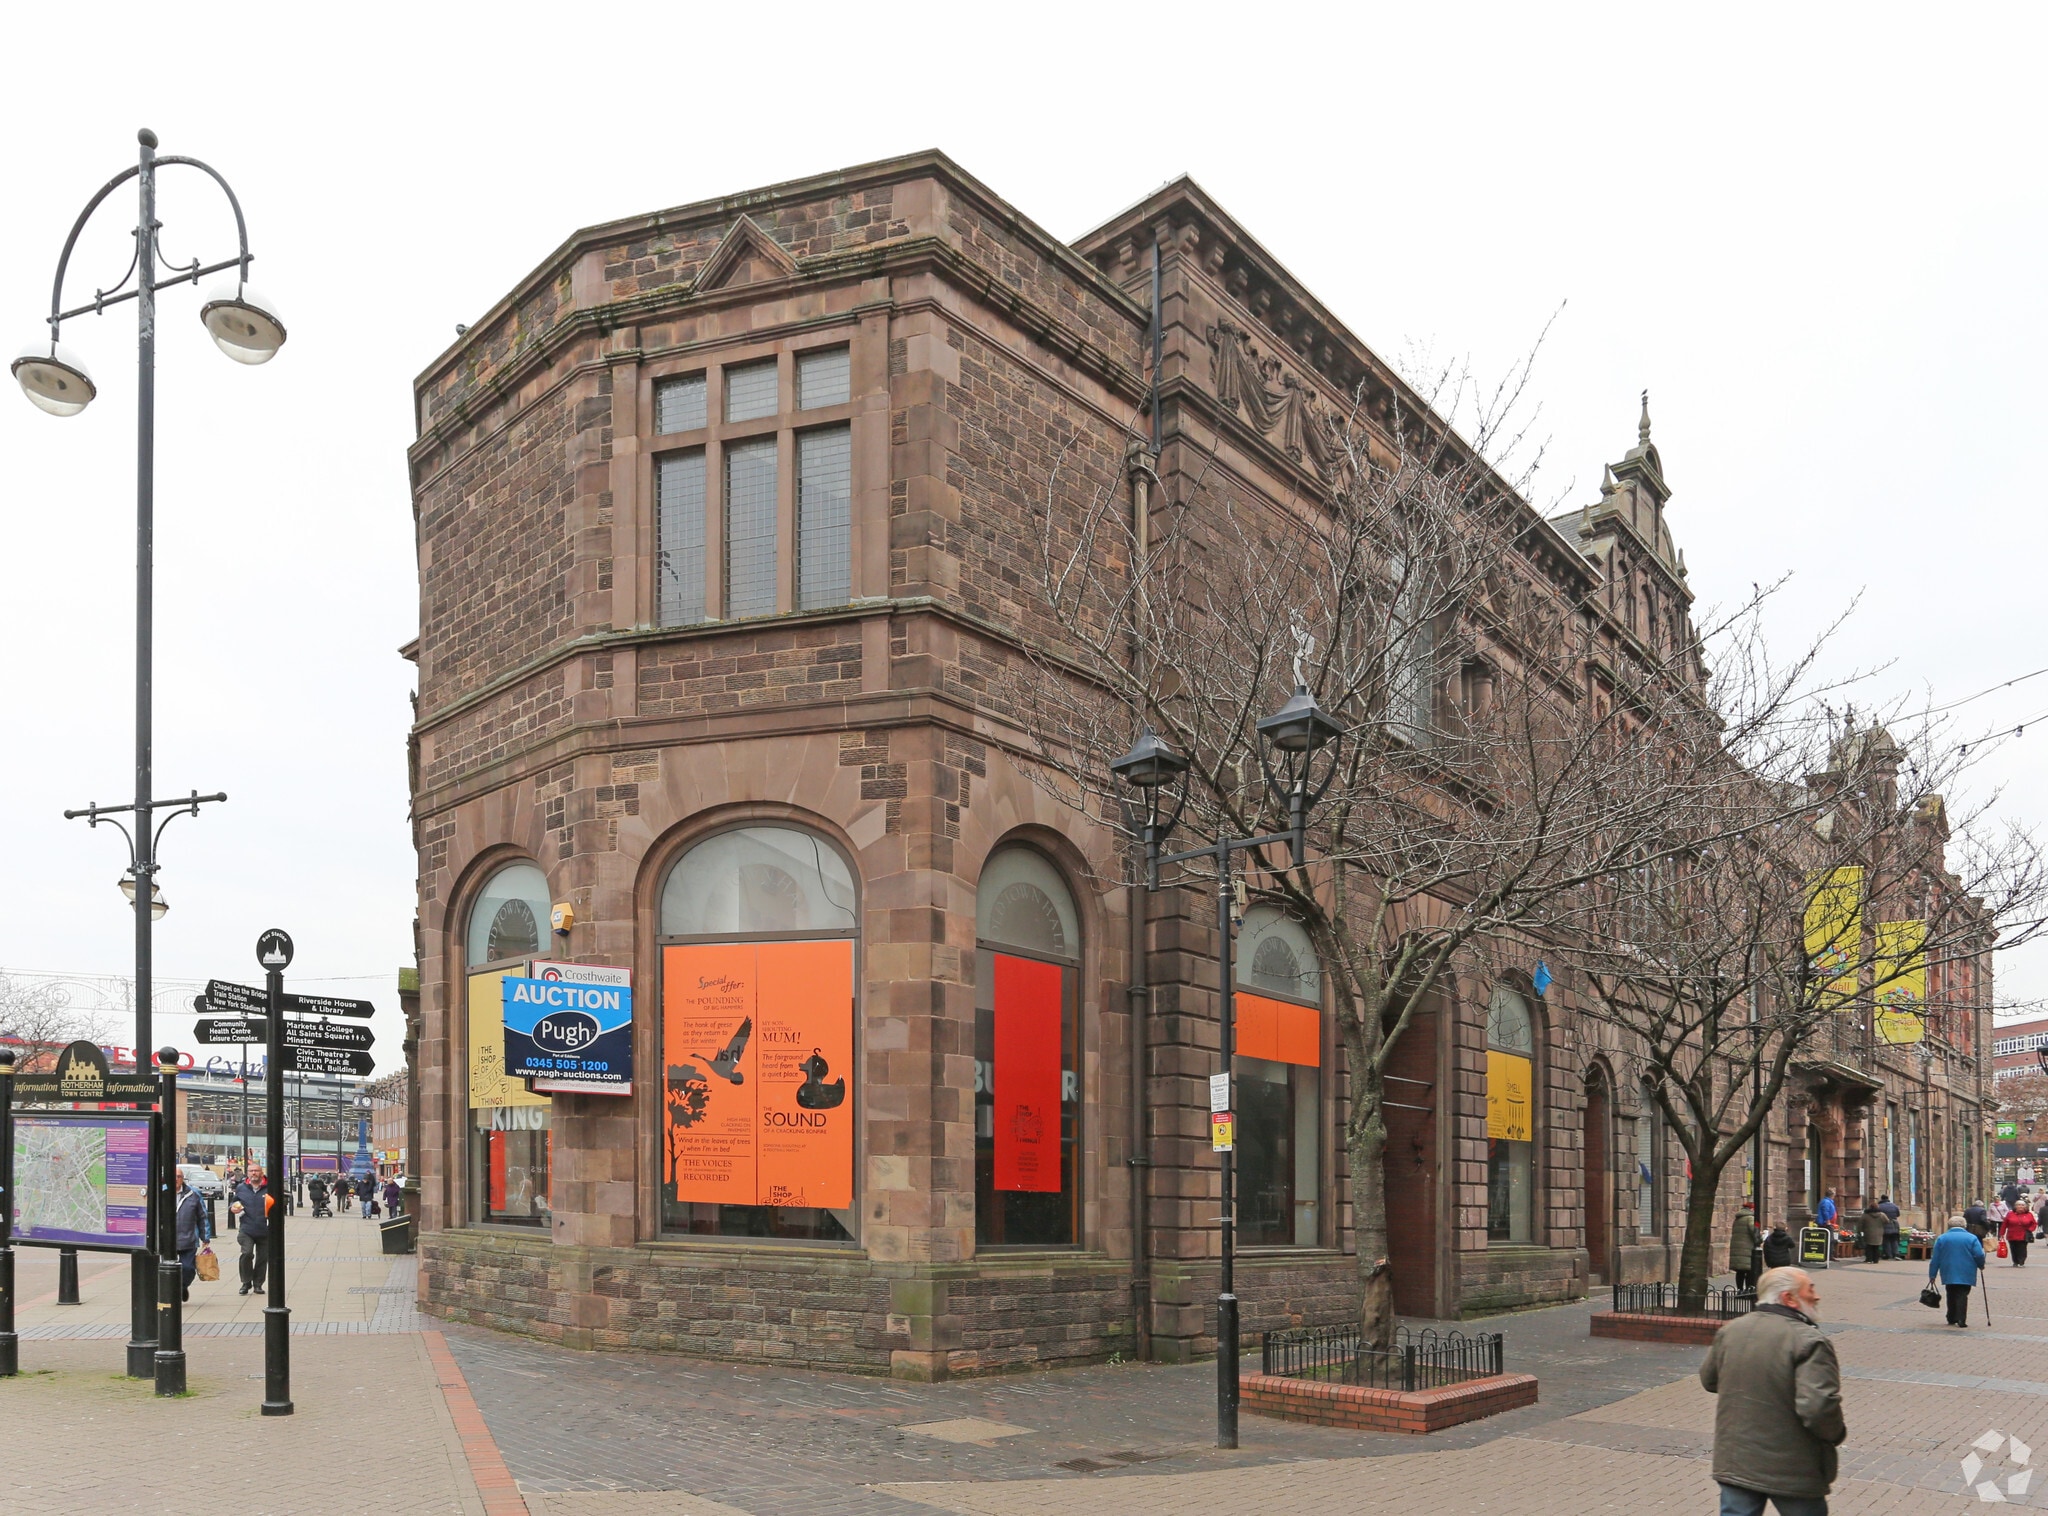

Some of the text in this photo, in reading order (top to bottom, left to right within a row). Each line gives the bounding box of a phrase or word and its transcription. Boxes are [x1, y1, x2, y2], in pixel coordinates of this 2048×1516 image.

[495, 901, 522, 925] TOWN
[521, 907, 538, 953] HALL
[261, 931, 288, 943] Bus Station
[564, 969, 622, 984] Crosthwaite
[697, 974, 728, 990] Special
[213, 982, 233, 993] Chapel
[241, 988, 250, 996] the
[251, 989, 268, 1000] Bridge
[720, 980, 745, 993] offer:
[213, 990, 248, 1002] Train Station
[513, 983, 620, 1010] AUCTION
[697, 996, 744, 1005] POUNDING
[213, 997, 226, 1006] New
[227, 999, 240, 1008] York
[240, 1002, 261, 1012] Stadium
[298, 996, 357, 1009] Riverside House
[319, 1005, 345, 1015] Library
[213, 1020, 247, 1028] Community
[286, 1021, 317, 1031] Markets
[325, 1025, 354, 1035] College
[710, 1021, 717, 1029] of
[298, 1030, 322, 1038] Saints
[324, 1032, 350, 1041] Square
[541, 1020, 590, 1046] Pugh
[762, 1032, 801, 1045] MUM!
[286, 1036, 315, 1045] Minster
[690, 1037, 699, 1045] for
[296, 1048, 344, 1058] Civic Theatre
[481, 1045, 493, 1054] THE
[296, 1055, 341, 1065] Clifton Park
[480, 1054, 497, 1065] SHOP
[774, 1053, 804, 1062] fairground
[296, 1062, 357, 1074] R.A.I.N. Building
[480, 1065, 489, 1074] OF
[526, 1057, 609, 1071] 0345 505 1200
[515, 1068, 622, 1081] www.pugh-auctions.com
[14, 1082, 58, 1093] information
[60, 1081, 104, 1089] ROTHERHAM
[106, 1082, 155, 1095] information
[1506, 1082, 1521, 1094] SMELL
[481, 1096, 503, 1106] THINGS
[491, 1105, 543, 1131] KING
[764, 1112, 827, 1128] SOUND
[729, 1138, 737, 1146] of
[683, 1159, 733, 1168] THE VOICES
[683, 1173, 730, 1182] RECORDED
